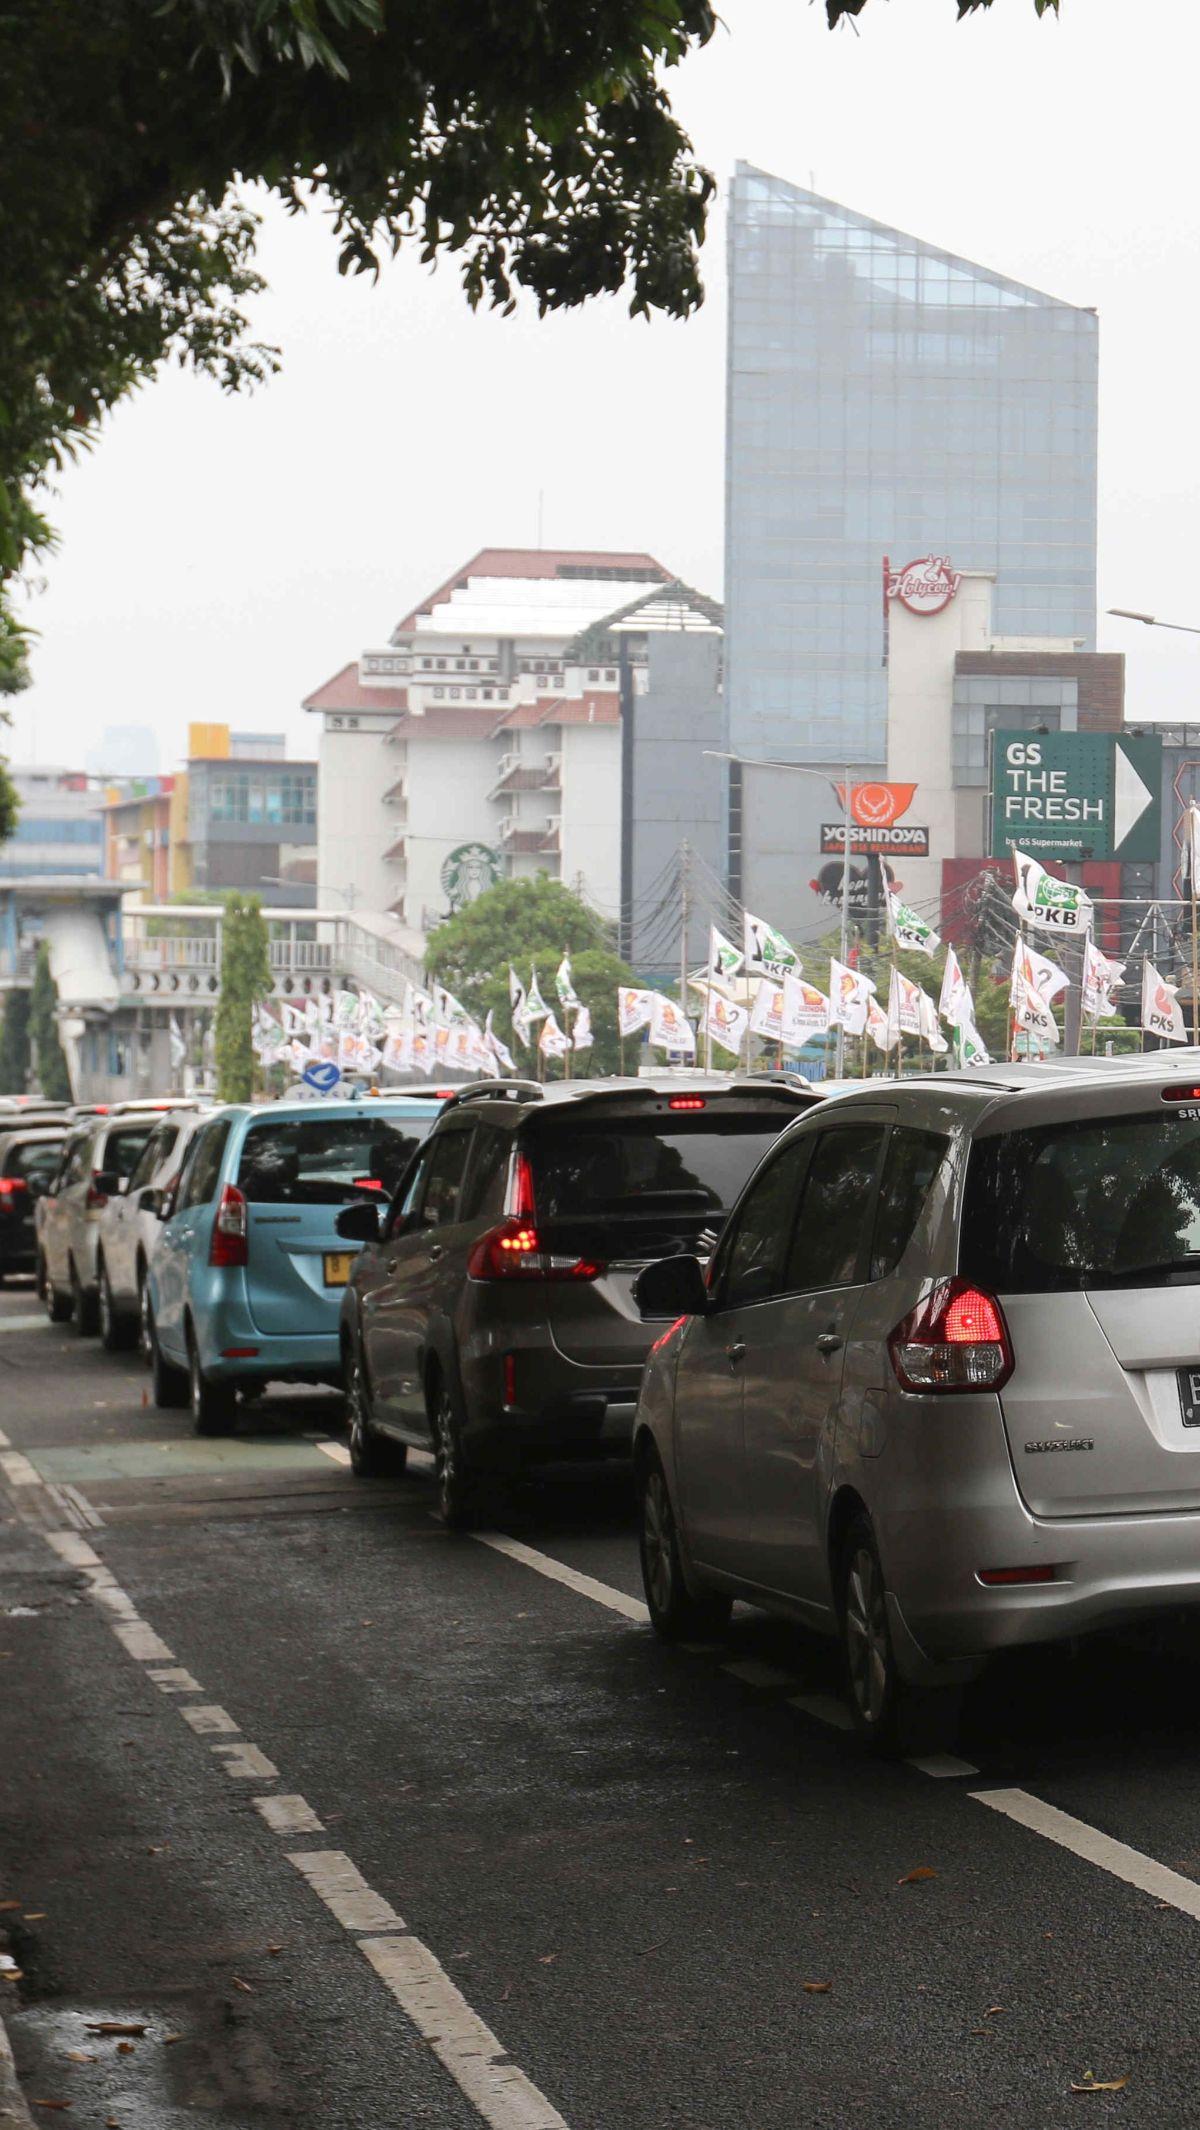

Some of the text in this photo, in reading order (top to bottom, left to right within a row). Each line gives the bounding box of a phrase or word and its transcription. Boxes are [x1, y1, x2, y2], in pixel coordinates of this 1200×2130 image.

[886, 573, 961, 598] Holycow!
[1006, 742, 1042, 765] GS
[1006, 770, 1067, 793] THE
[1005, 796, 1104, 821] FRESH
[823, 826, 927, 843] YOSHINOYA
[1018, 837, 1031, 846] GS
[1031, 838, 1083, 848] Supermarket
[824, 841, 868, 852] JAPAESE
[1034, 906, 1077, 926] PKB
[1024, 1011, 1048, 1027] PKS
[1150, 1014, 1175, 1033] PKS
[1178, 1108, 1200, 1119] SR
[1024, 1439, 1095, 1453] SUZUKI
